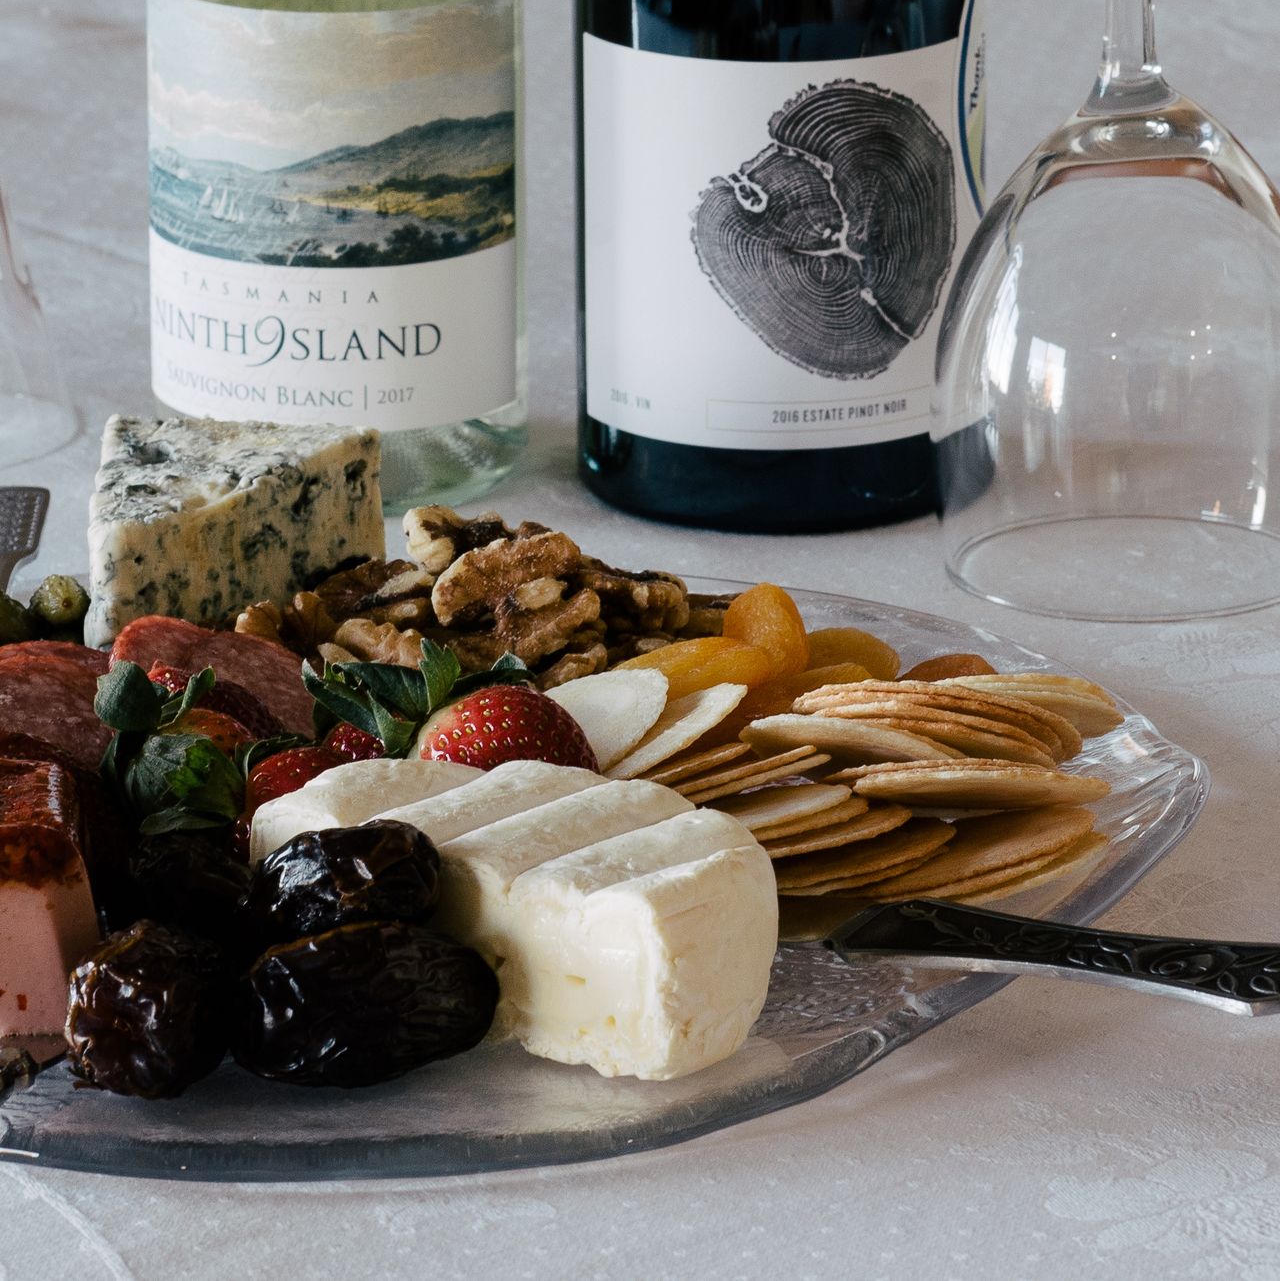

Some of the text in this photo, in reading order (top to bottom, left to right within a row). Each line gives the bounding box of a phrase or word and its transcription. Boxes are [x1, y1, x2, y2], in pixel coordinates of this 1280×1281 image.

[182, 271, 379, 303] TASMANIA
[377, 387, 415, 405] 2017
[772, 399, 907, 423] 2016 ESTATE PINOT NOIR
